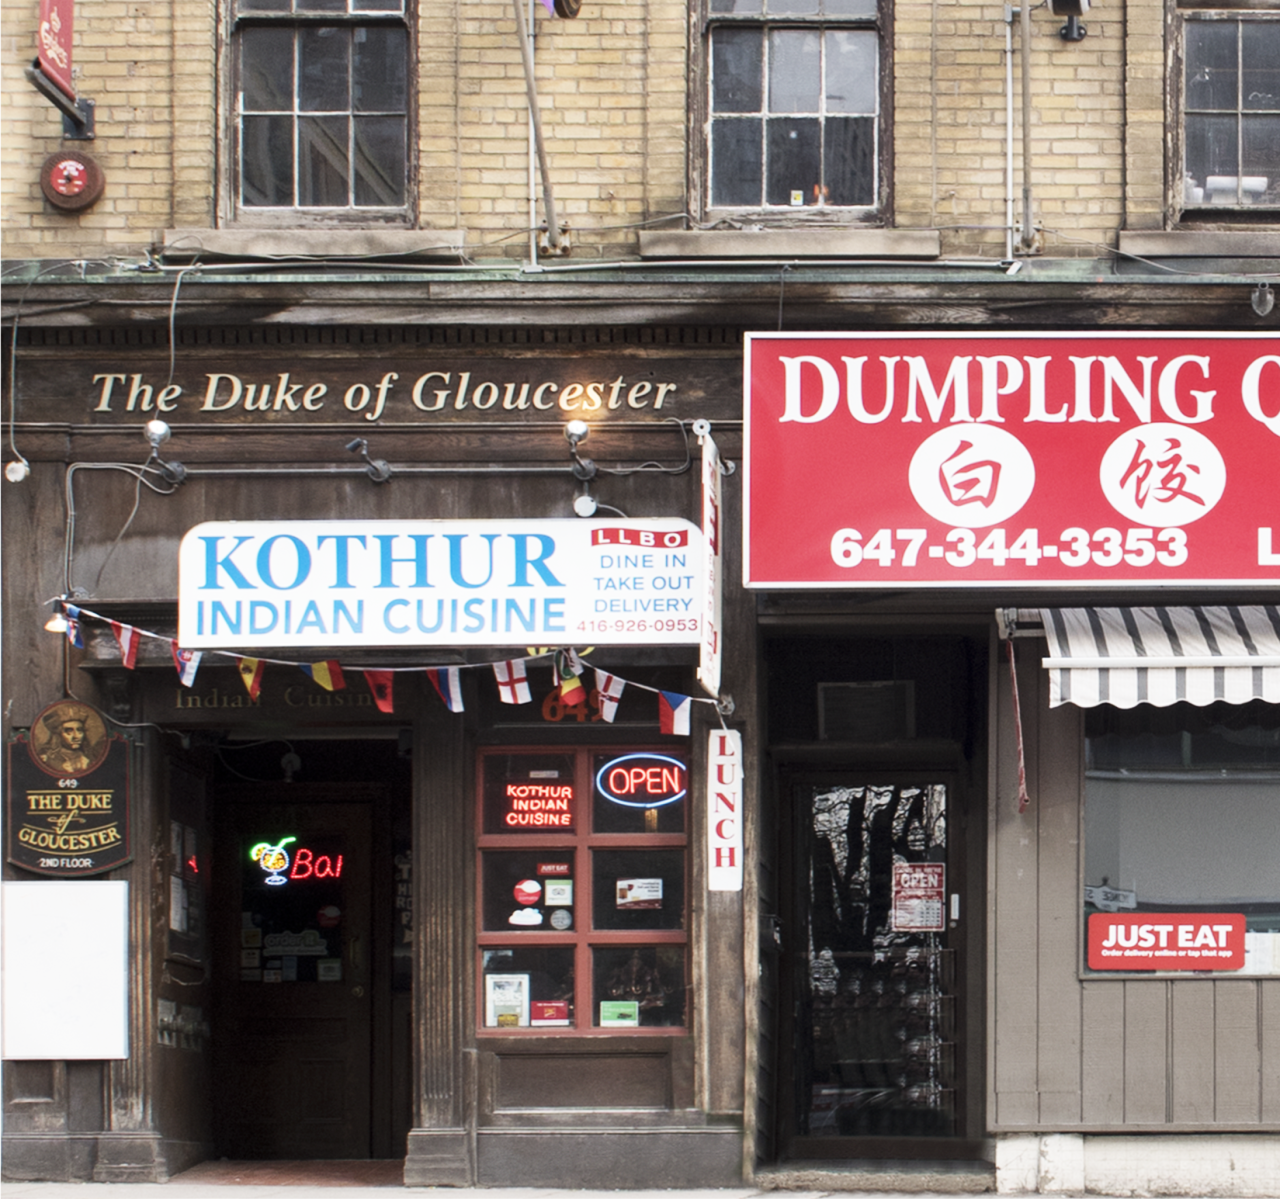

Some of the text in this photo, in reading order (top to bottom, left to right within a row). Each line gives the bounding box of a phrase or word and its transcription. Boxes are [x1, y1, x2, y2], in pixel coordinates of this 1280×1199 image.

[94, 371, 677, 421] The Duke of Gloucester
[779, 355, 1216, 424] DUMPLING
[831, 526, 1189, 568] 647-344-3353
[197, 533, 566, 591] KOTHUR
[600, 554, 686, 569] DINE IN
[593, 575, 694, 591] TAKE OUT
[595, 598, 693, 613] DELIVERY
[197, 597, 566, 636] INDIAN CUISINE
[577, 618, 698, 633] 416-926-0953
[284, 685, 374, 708] Cuisin
[609, 767, 680, 794] OPEN
[506, 785, 573, 799] KOTHUR
[27, 794, 112, 810] THE DUKE
[513, 799, 568, 811] INDIAN
[715, 735, 736, 868] LUNCH
[506, 813, 572, 826] CUISINE
[18, 827, 122, 850] GLOUCESTER
[39, 858, 93, 868] 2ND FLOOR
[901, 873, 938, 888] OPEN
[1102, 924, 1233, 948] JUST EAT
[1101, 949, 1123, 957] Order
[1124, 949, 1153, 958] delivery
[1154, 949, 1177, 957] online
[1187, 950, 1200, 958] tap
[1201, 949, 1217, 957] that
[1218, 950, 1233, 958] app
